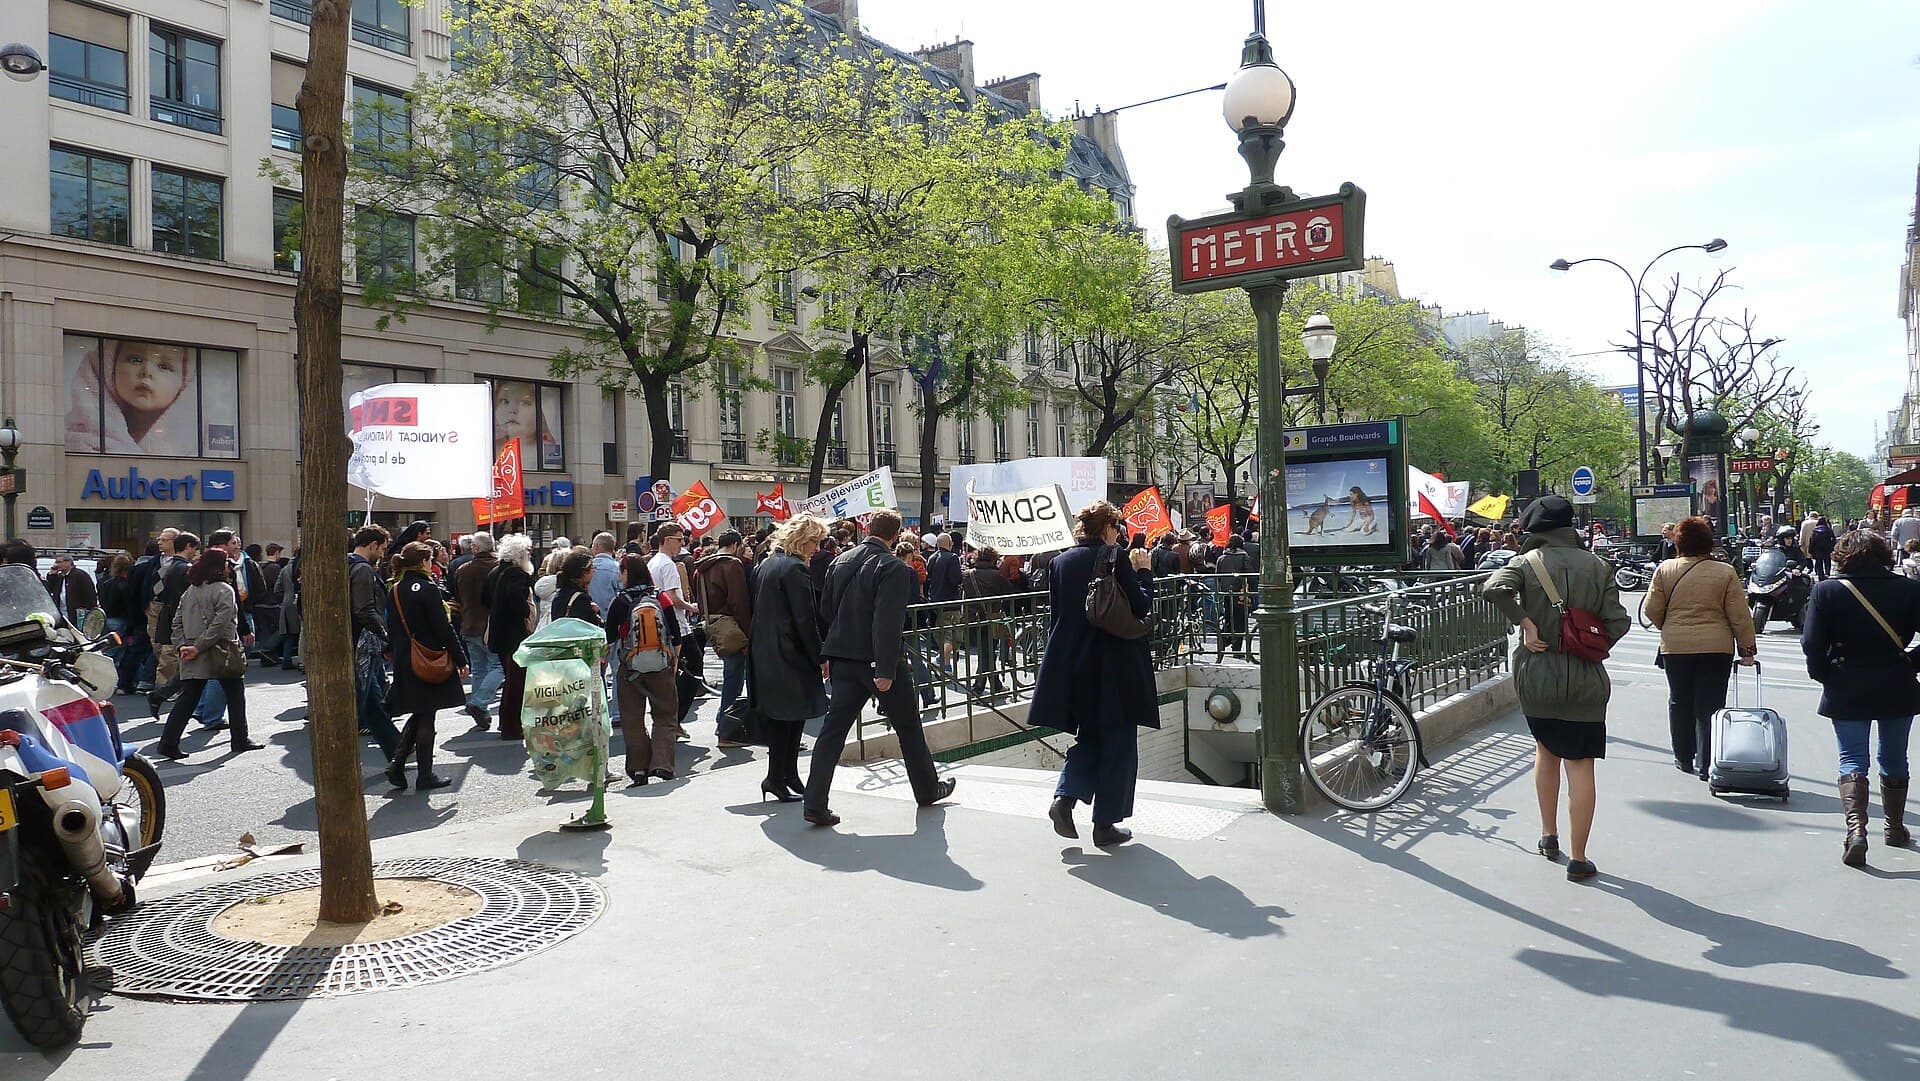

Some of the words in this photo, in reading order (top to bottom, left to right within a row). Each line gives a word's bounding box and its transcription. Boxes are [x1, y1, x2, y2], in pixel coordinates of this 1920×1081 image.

[1190, 216, 1333, 273] METRO
[1294, 436, 1300, 445] 9
[1311, 433, 1338, 444] Grands
[1339, 431, 1381, 441] Boulevards
[1733, 460, 1769, 470] METRO
[81, 467, 197, 500] Aubert
[826, 472, 881, 501] télévisions
[534, 679, 585, 699] VIGILANCE
